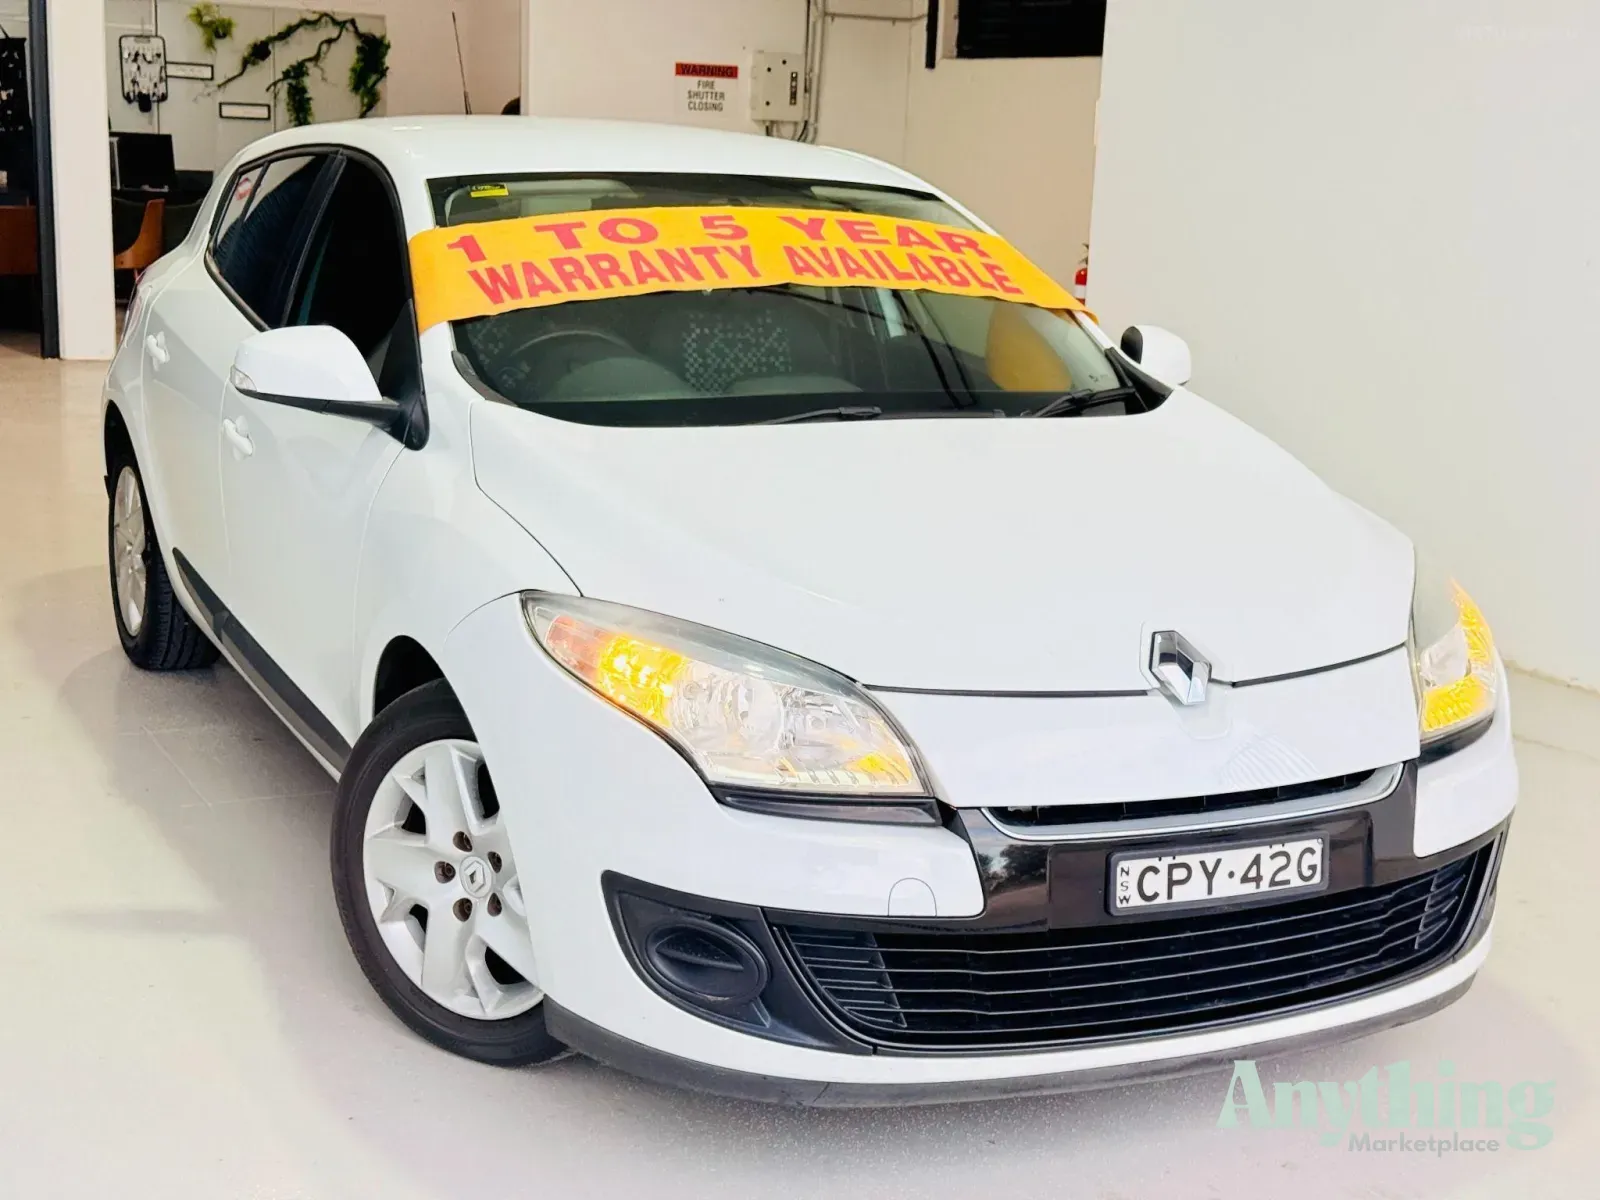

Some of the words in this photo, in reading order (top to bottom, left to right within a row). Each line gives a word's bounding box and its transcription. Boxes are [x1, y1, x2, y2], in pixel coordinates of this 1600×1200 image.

[681, 64, 733, 77] WARNING
[697, 80, 715, 90] FIRE
[687, 90, 725, 101] SHUTTER
[687, 101, 723, 112] CLOSING
[447, 235, 486, 263] 1
[534, 217, 658, 250] TO
[700, 215, 748, 240] 5
[777, 216, 992, 259] YEAR
[467, 246, 760, 305] WARRANTY
[783, 246, 1023, 294] AVAILABLE
[1119, 866, 1131, 905] NSW
